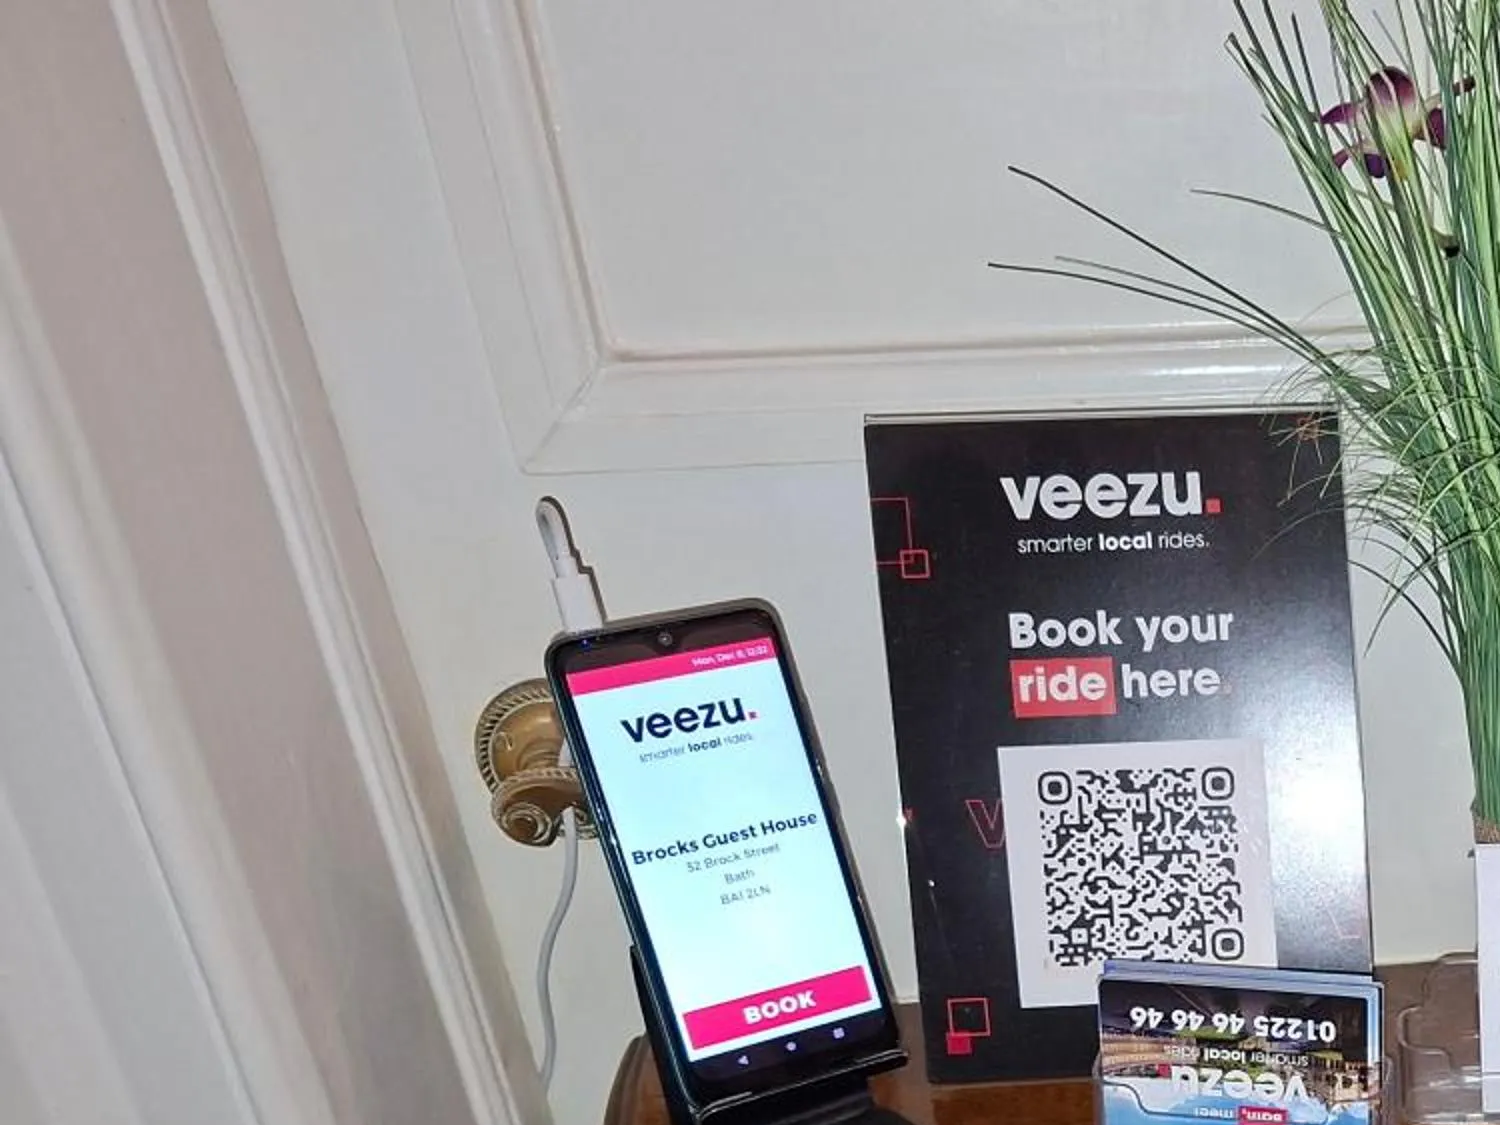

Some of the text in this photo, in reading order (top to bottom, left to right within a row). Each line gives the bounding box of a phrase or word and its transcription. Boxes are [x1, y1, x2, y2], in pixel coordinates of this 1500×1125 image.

[1000, 471, 1222, 522] veezu.
[1017, 530, 1211, 554] smarter local rides.
[1008, 609, 1234, 652] Book your
[1017, 664, 1107, 704] ride
[620, 697, 759, 743] veezu.
[687, 736, 723, 752] local
[631, 812, 818, 865] Brocks Guest House
[703, 852, 742, 869] Brock
[744, 843, 781, 858] Street
[723, 867, 756, 885] Bath
[742, 989, 818, 1026] BOOK
[1129, 1006, 1337, 1043] 01225 46 46 46
[1203, 1047, 1246, 1064] local
[1157, 1063, 1309, 1102] veezu.
